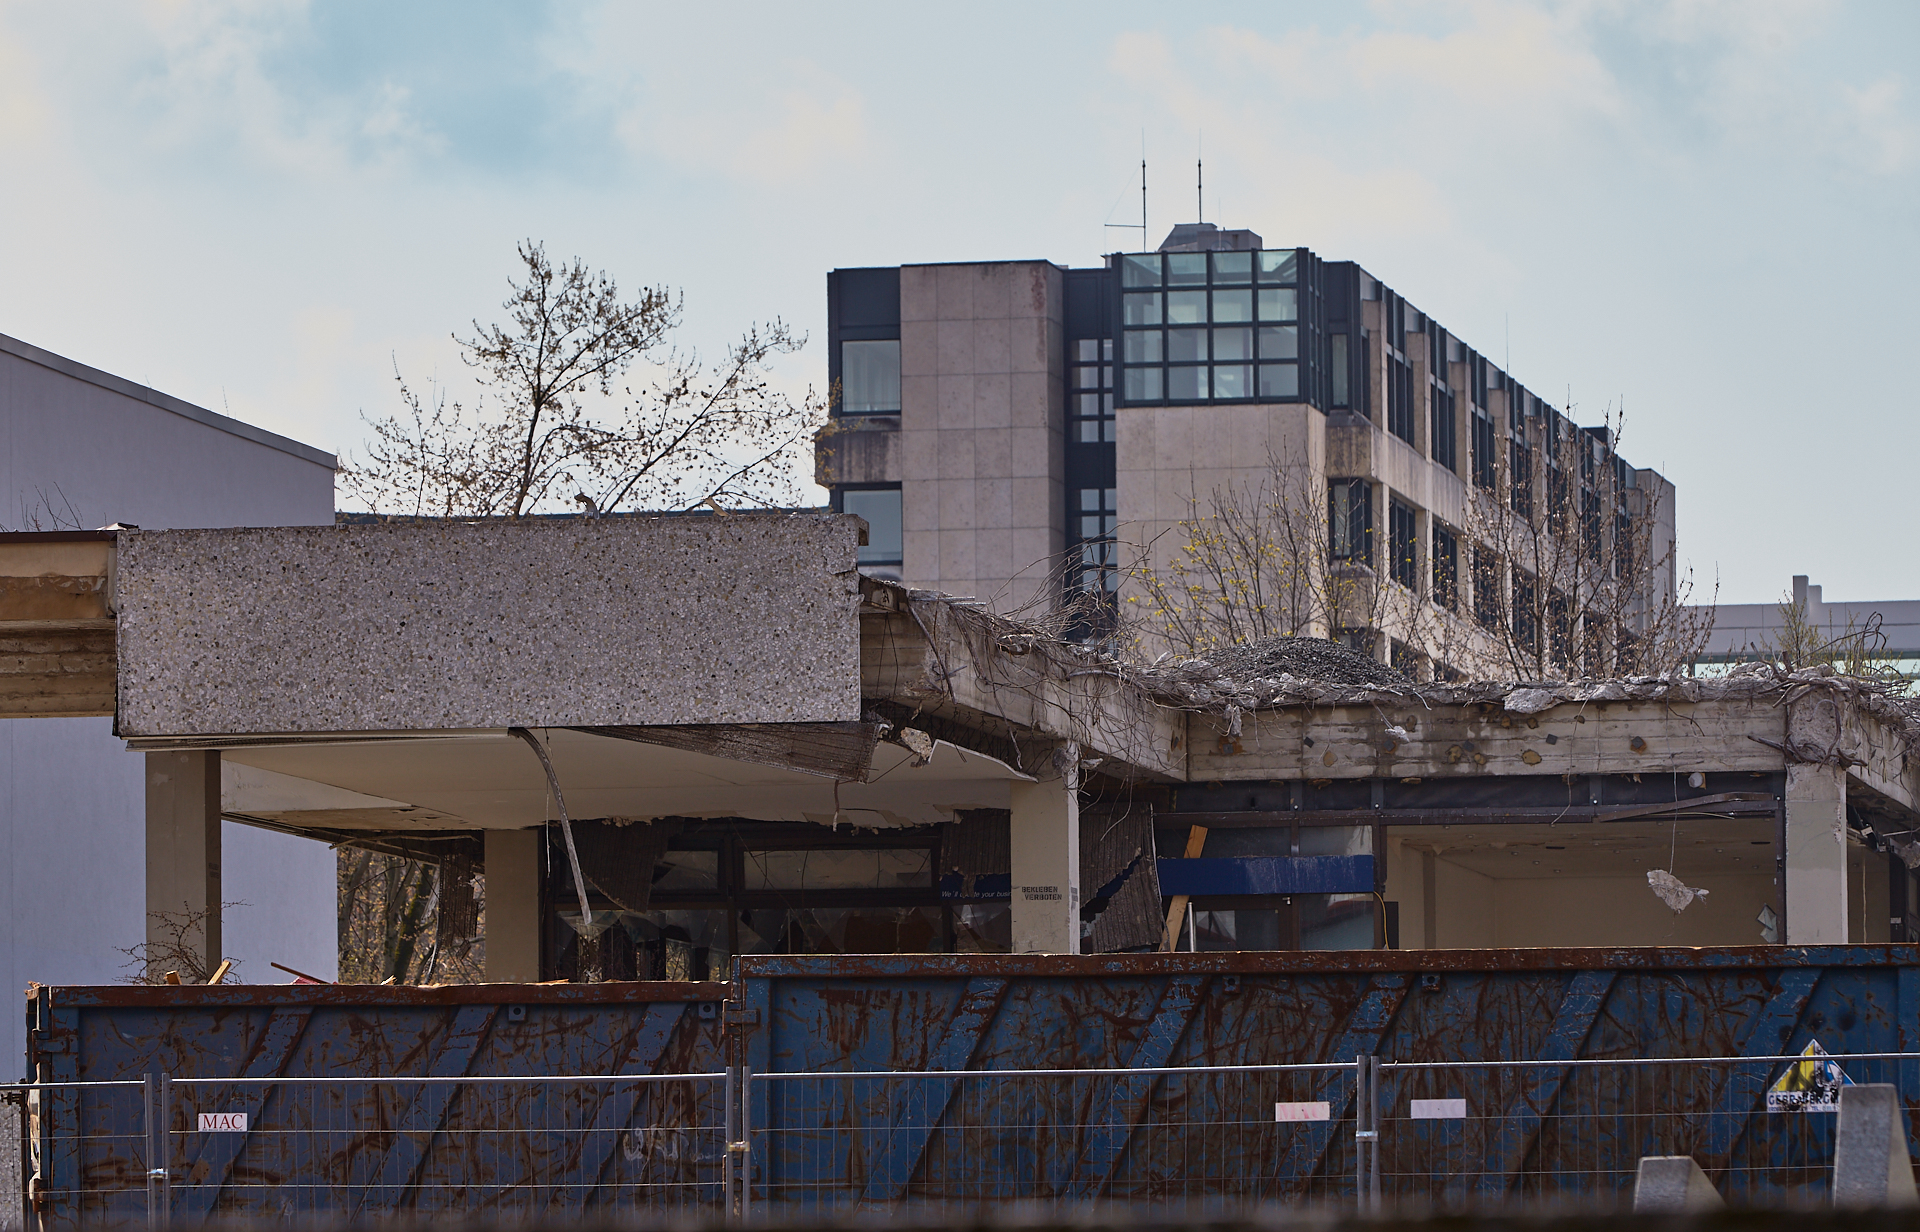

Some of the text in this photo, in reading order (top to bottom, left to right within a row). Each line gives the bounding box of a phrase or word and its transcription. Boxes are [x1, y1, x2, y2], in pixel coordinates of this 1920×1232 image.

[981, 891, 995, 899] your
[1278, 1104, 1325, 1120] MAC
[203, 1113, 243, 1129] MAC
